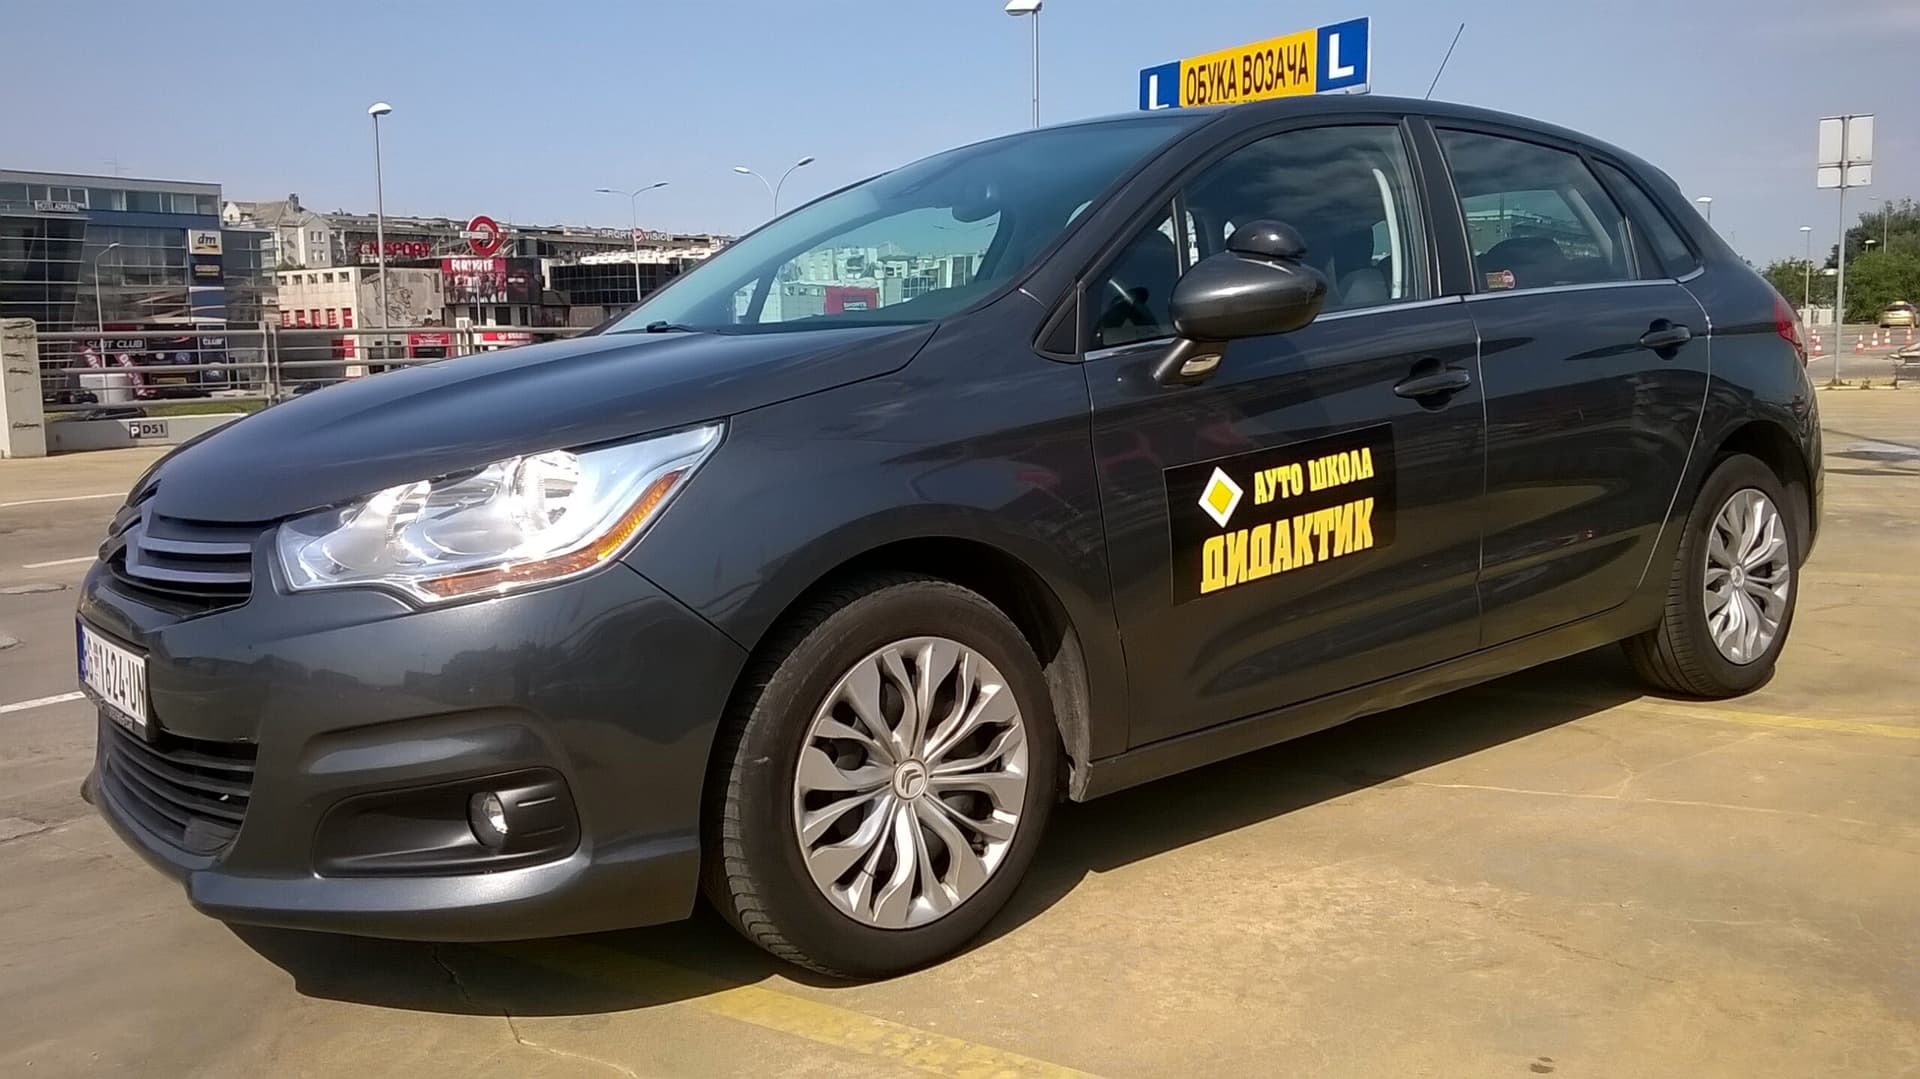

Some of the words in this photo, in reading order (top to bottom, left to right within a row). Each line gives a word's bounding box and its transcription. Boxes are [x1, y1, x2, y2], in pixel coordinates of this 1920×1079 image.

[1186, 61, 1236, 105] ОБУКА
[1242, 41, 1309, 96] ВОЗАЧА
[1329, 32, 1355, 80] L
[1148, 74, 1169, 110] L
[198, 233, 216, 244] dm
[116, 339, 143, 348] CLUB
[142, 423, 164, 434] D51
[1253, 462, 1303, 506] АУТО
[1308, 447, 1375, 492] ШКОЛА
[1200, 496, 1375, 595] ДИДАКТИК
